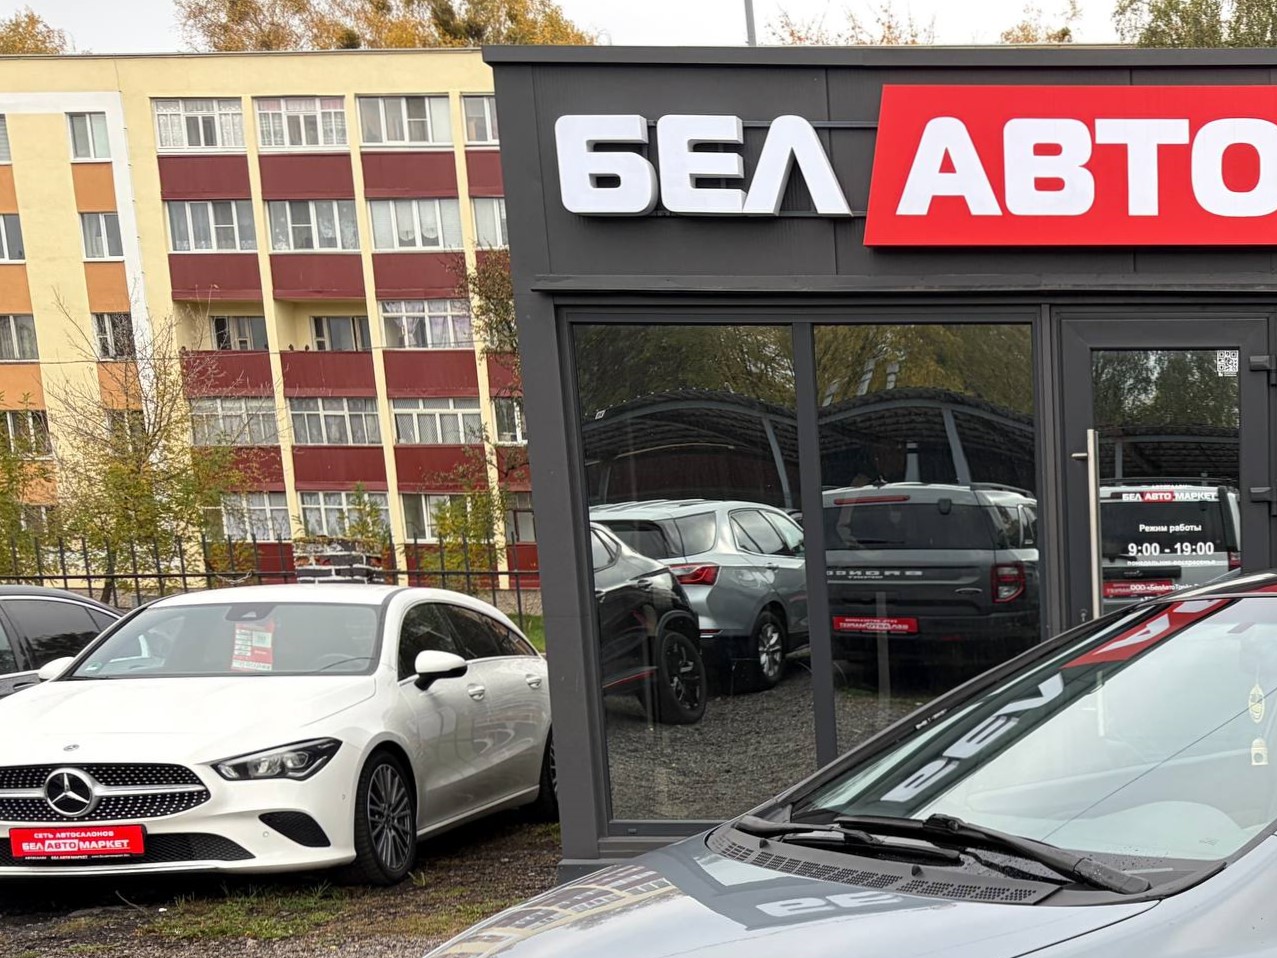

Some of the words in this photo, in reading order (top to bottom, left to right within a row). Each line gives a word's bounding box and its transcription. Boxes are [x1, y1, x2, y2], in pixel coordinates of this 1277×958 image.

[555, 114, 853, 217] БЕЛ
[1122, 493, 1142, 501] БЕЛ
[1144, 493, 1171, 501] АВТО
[1174, 493, 1216, 501] МАРКЕТ
[1139, 524, 1168, 532] Режим
[1170, 523, 1202, 533] работы
[1128, 543, 1160, 556] 9:00
[1174, 542, 1214, 555] 19:00
[22, 842, 44, 851] БЕЛ
[46, 841, 77, 850] АВТО
[80, 840, 129, 850] МАРКЕТ
